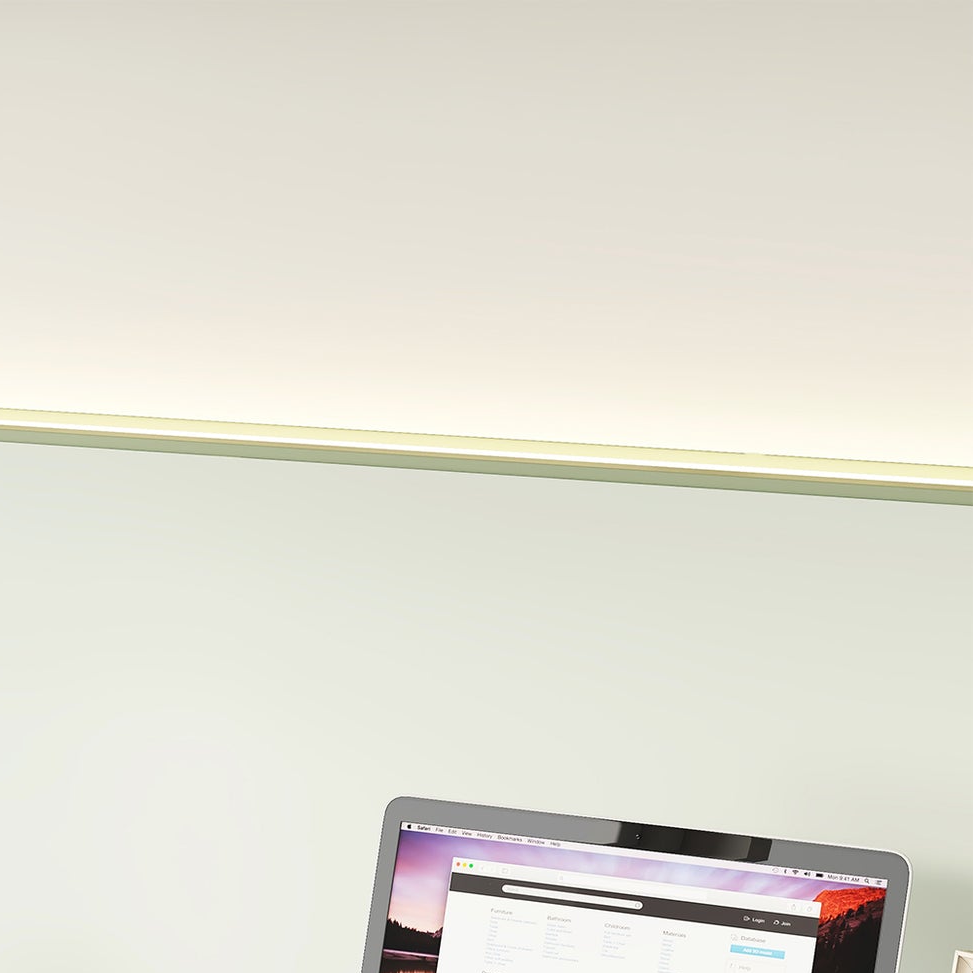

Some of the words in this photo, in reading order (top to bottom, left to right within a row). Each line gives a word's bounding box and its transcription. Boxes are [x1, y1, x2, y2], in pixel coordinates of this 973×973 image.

[476, 832, 493, 840] History
[497, 835, 523, 843] Bookmarks
[527, 838, 545, 846] Window
[490, 907, 513, 915] Furniture
[547, 915, 572, 923] Bathroom
[662, 930, 687, 939] Materials
[740, 935, 766, 943] Database
